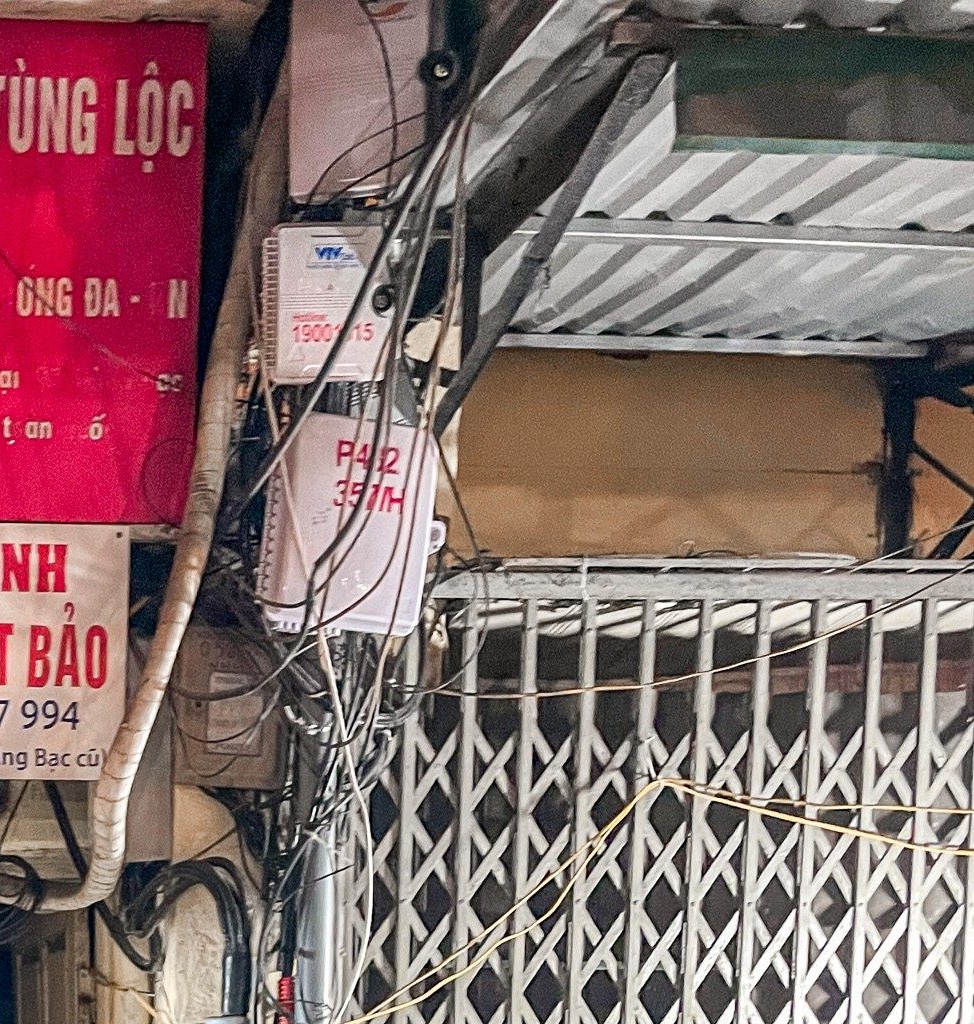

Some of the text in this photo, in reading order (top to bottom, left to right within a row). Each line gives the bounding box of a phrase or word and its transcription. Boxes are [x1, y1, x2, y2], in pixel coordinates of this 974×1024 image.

[114, 61, 194, 173] LỘC
[28, 602, 108, 690] BẢO
[20, 699, 80, 731] 994
[35, 748, 71, 773] Bạc
